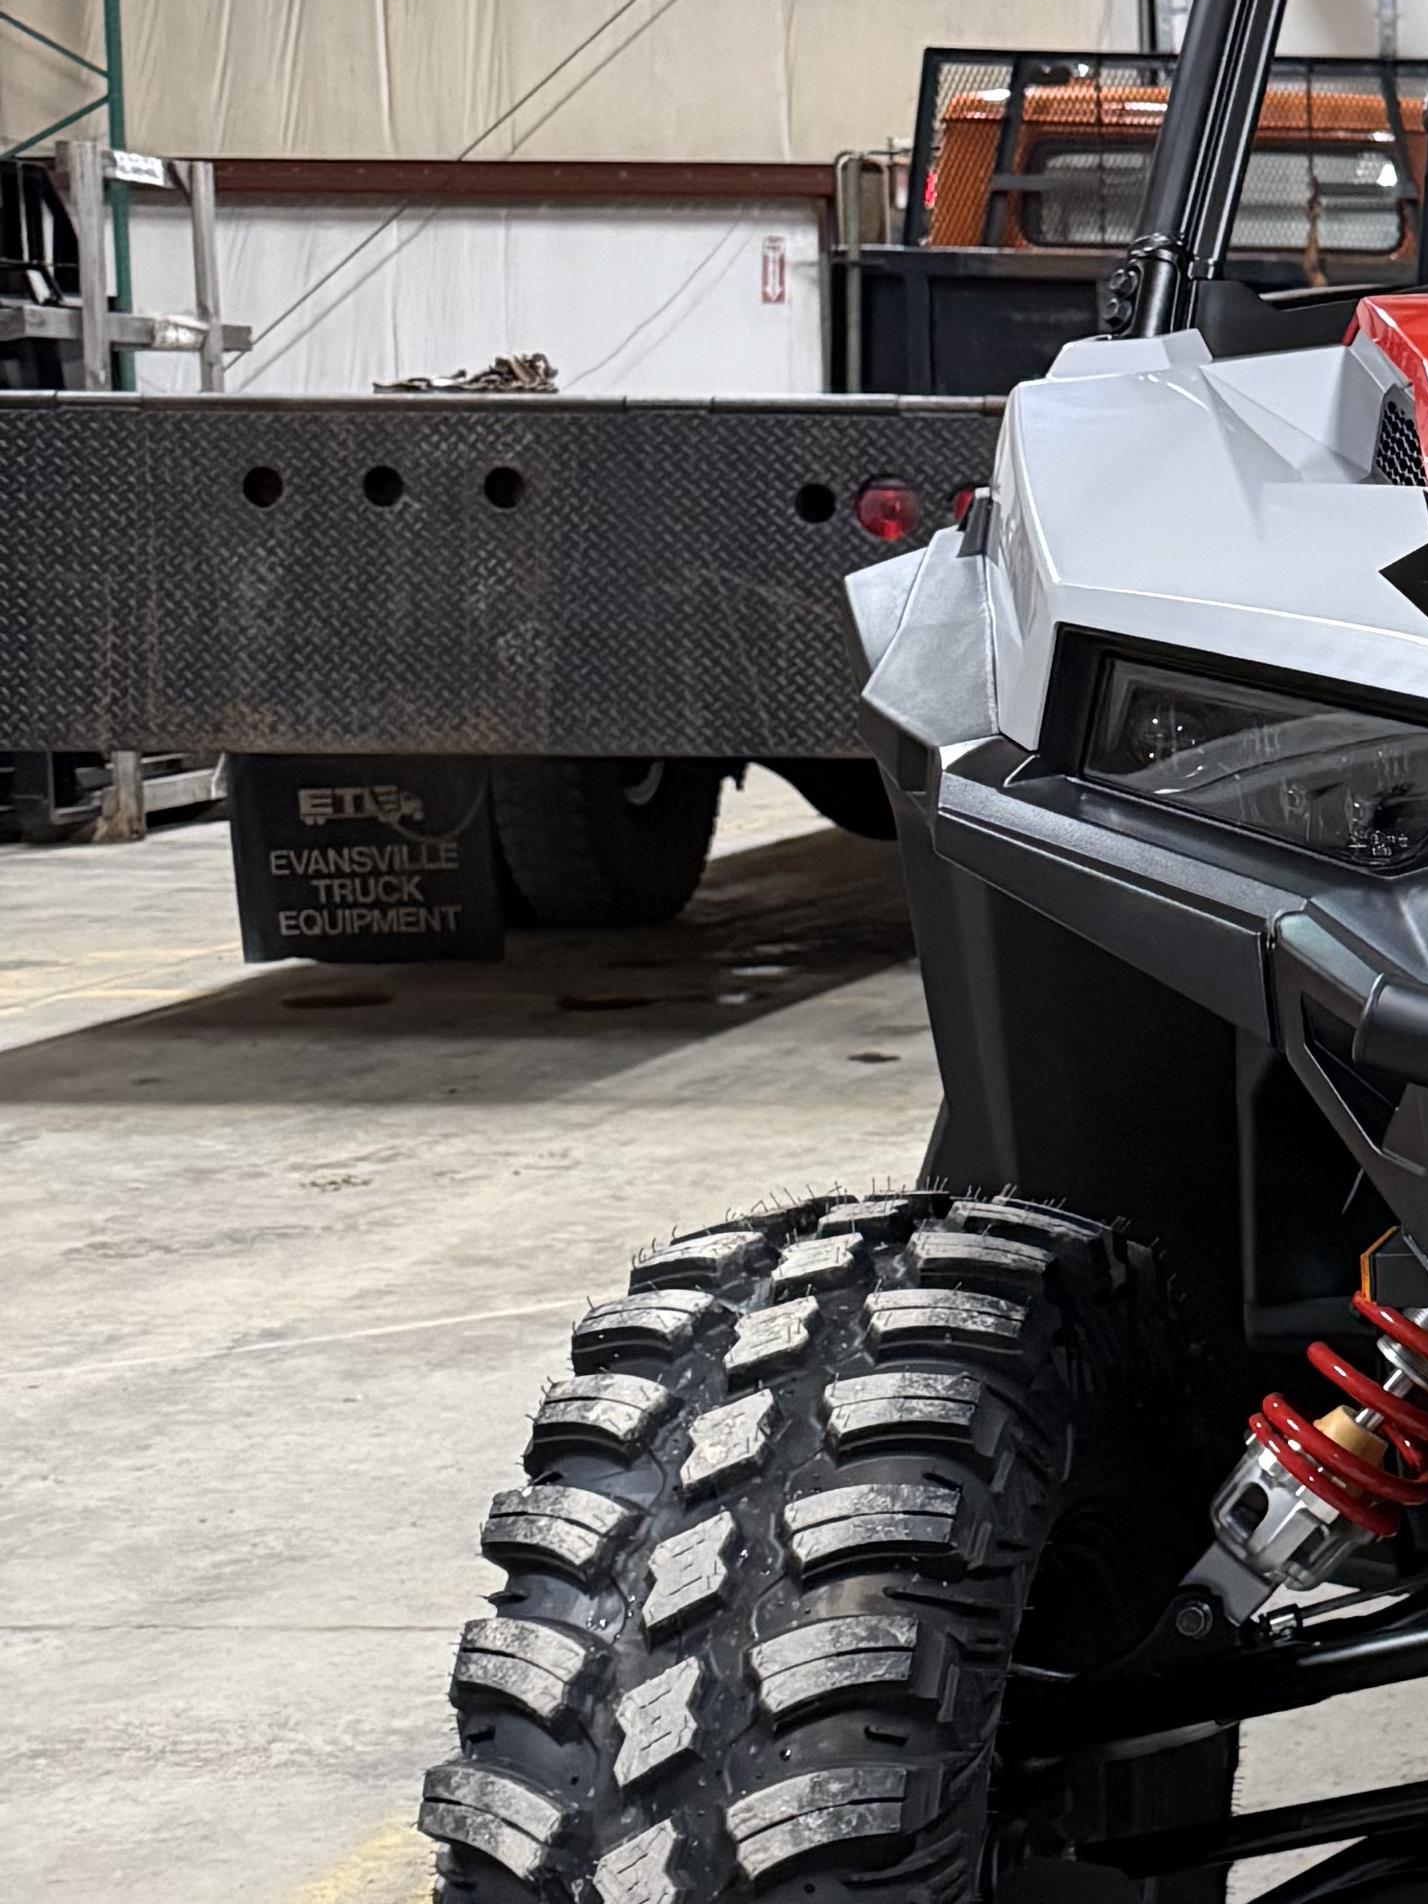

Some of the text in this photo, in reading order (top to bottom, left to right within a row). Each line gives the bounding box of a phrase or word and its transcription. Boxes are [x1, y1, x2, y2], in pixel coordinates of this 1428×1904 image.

[269, 843, 459, 875] EVANSVILLE
[310, 875, 424, 904] TRUCK
[278, 904, 462, 936] EQUIPMENT
